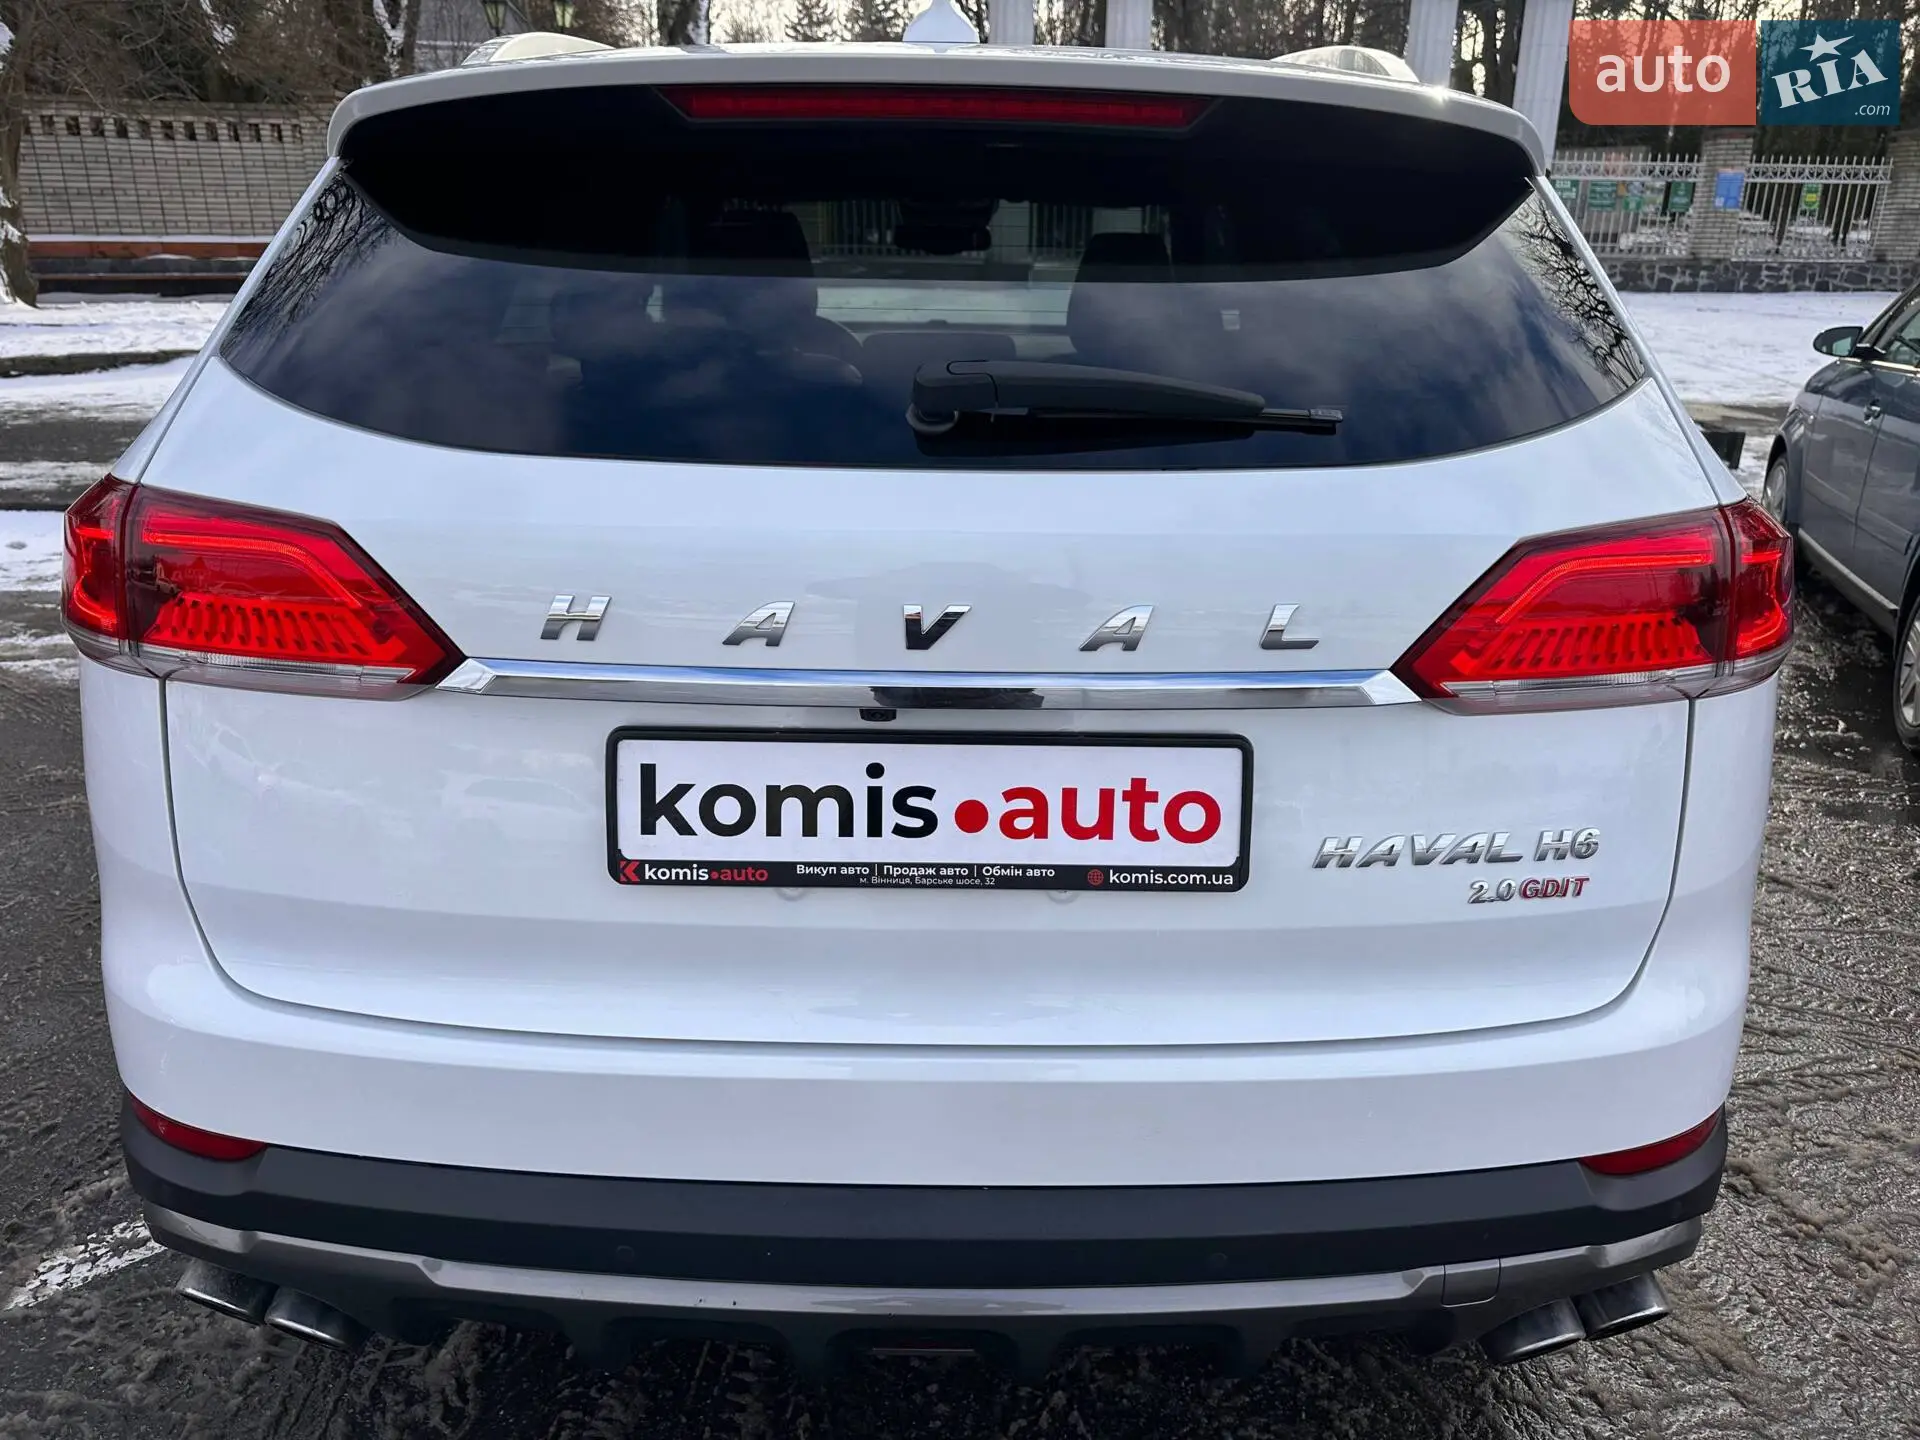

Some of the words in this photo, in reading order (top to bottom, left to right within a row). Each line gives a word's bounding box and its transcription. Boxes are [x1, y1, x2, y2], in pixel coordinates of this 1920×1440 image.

[540, 594, 1321, 652] HAVAL
[1312, 831, 1524, 869] HAVAL
[1533, 827, 1601, 862] H6
[796, 864, 837, 878] Викуп
[840, 866, 870, 875] авто
[883, 865, 937, 878] Продаж
[939, 867, 969, 876] авто
[982, 866, 1023, 877] Обмін
[1025, 868, 1056, 877] авто
[1109, 869, 1234, 885] komis.com.ua
[871, 876, 913, 885] Вінниця,
[914, 876, 954, 885] Барське
[955, 878, 983, 886] шосе,
[984, 877, 996, 886] 32
[1467, 879, 1516, 904] 2.0
[1519, 876, 1590, 900] GDIT
